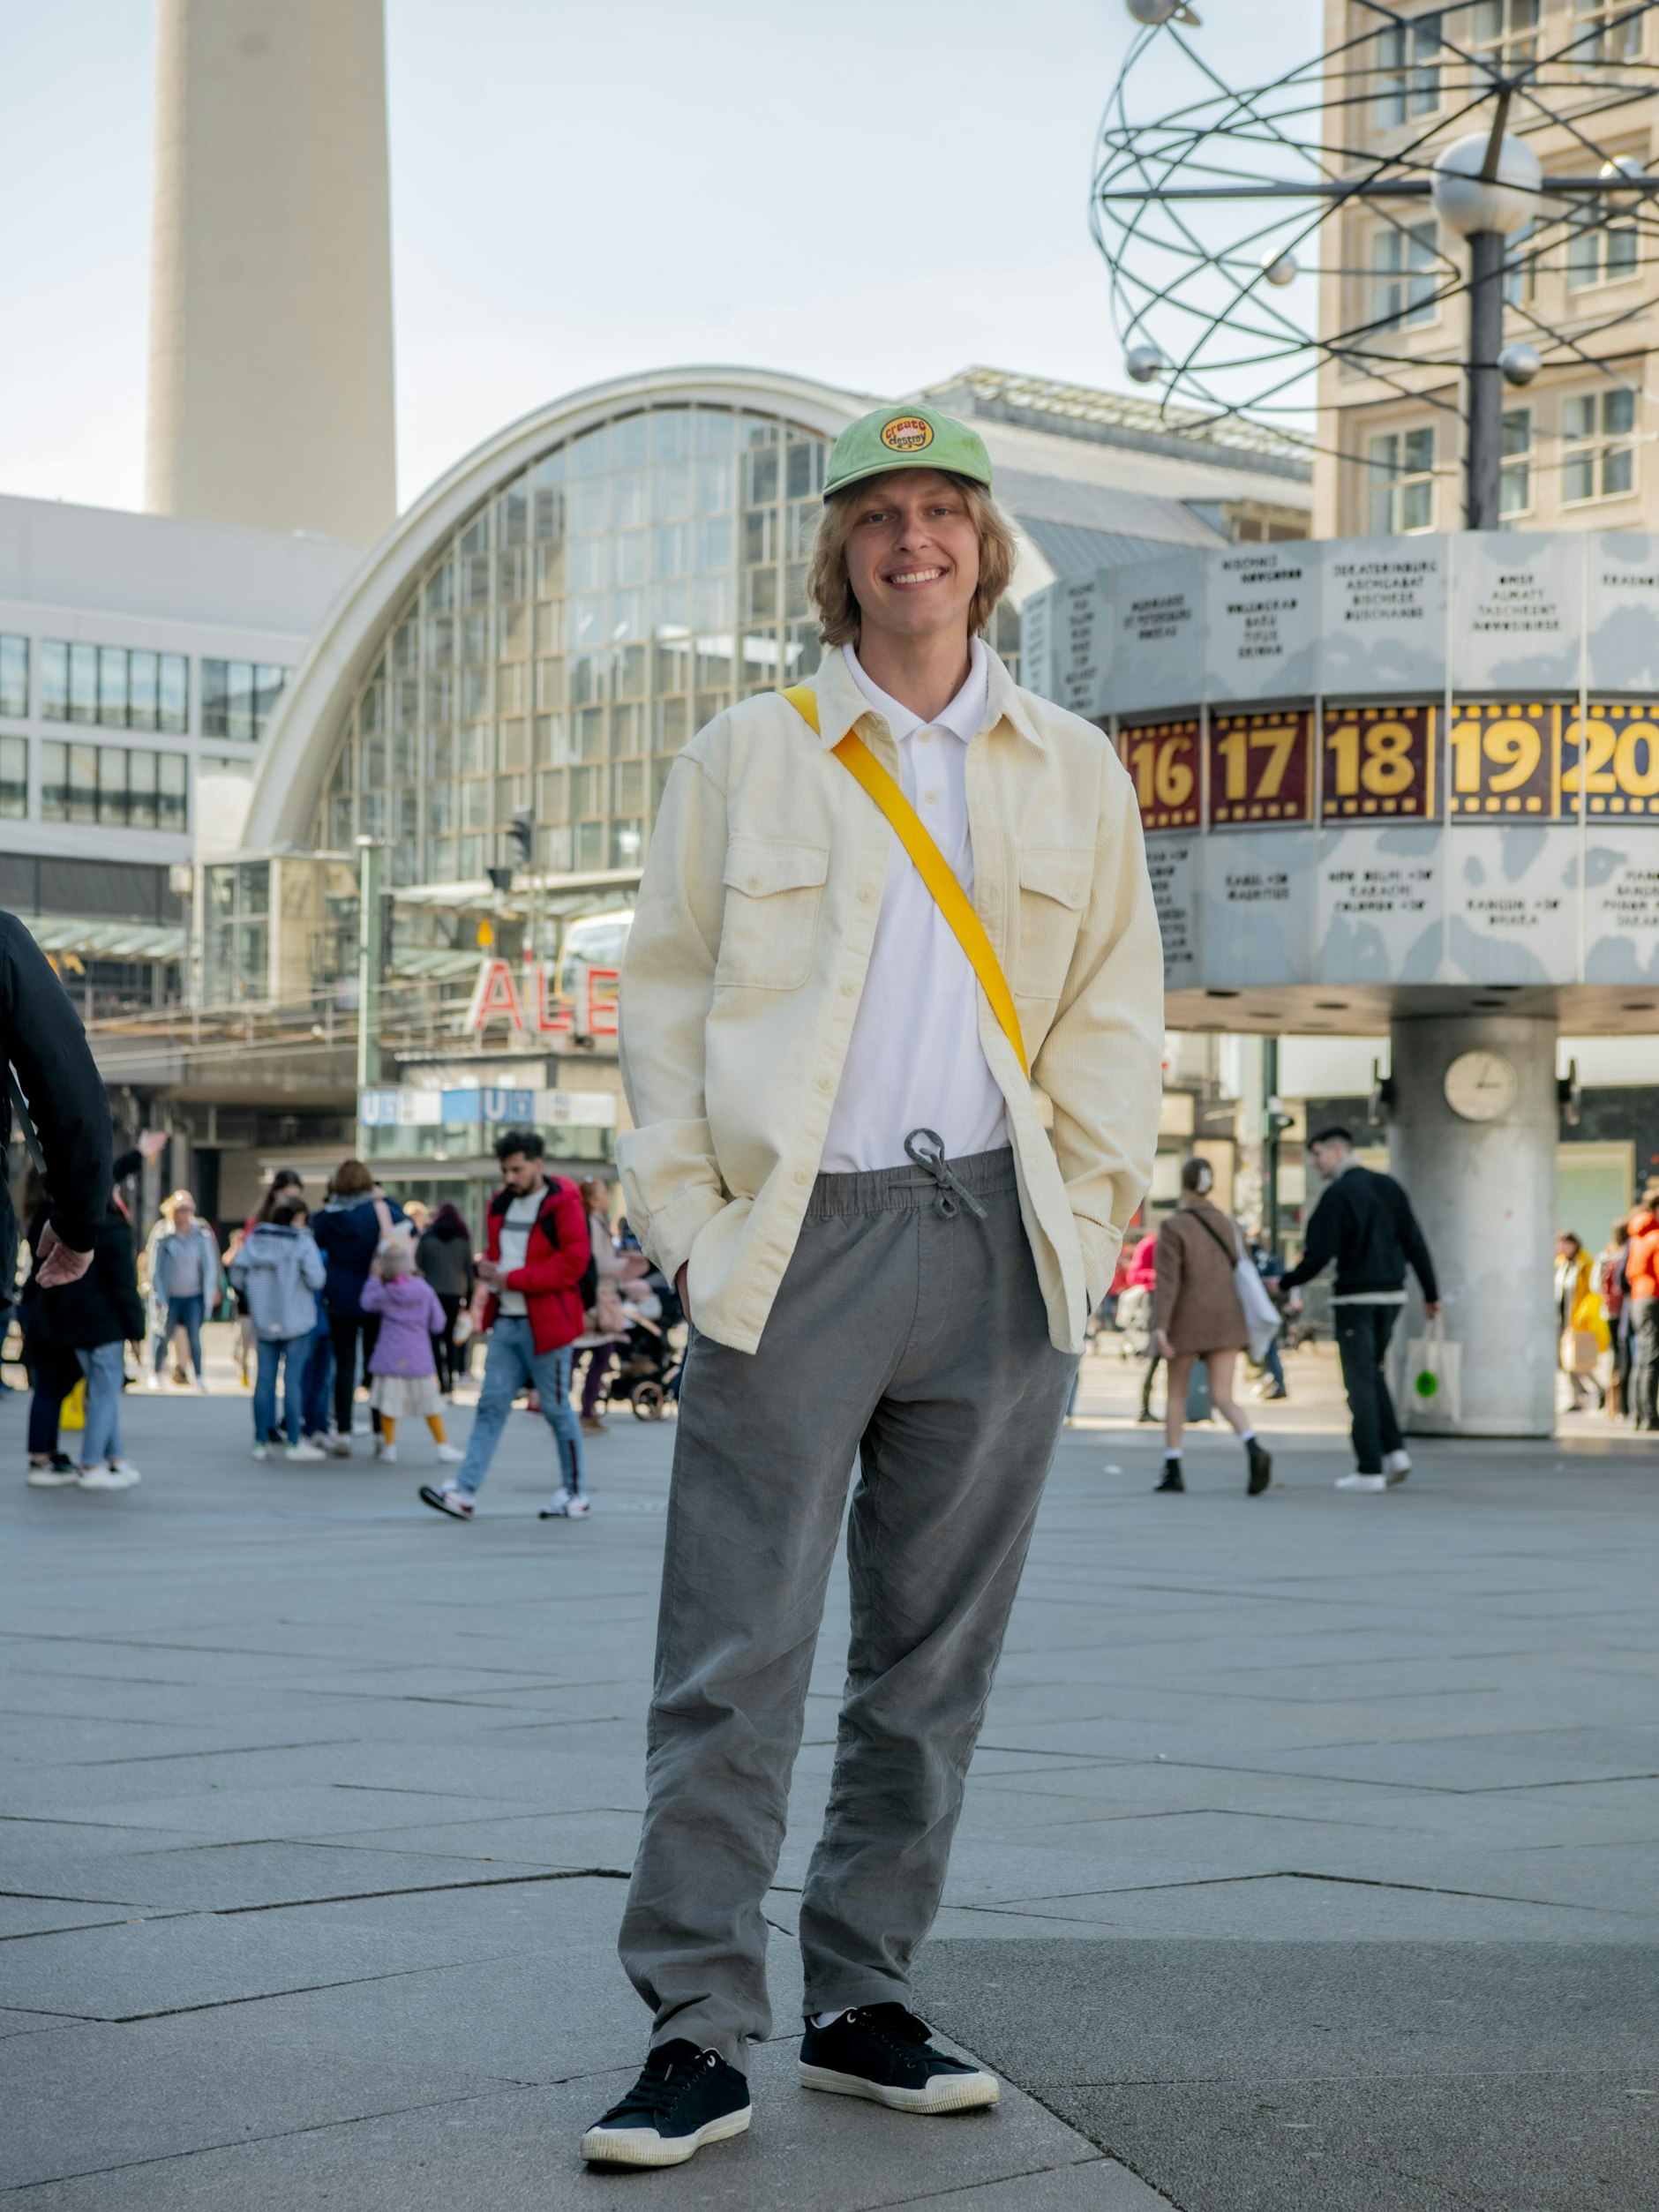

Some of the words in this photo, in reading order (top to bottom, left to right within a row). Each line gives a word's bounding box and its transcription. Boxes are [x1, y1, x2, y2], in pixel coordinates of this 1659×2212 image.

[885, 420, 927, 439] create
[889, 431, 927, 446] destroy
[1130, 736, 1196, 808] 16
[1217, 726, 1299, 801] 17
[1326, 721, 1415, 796] 18
[1449, 719, 1543, 794] 19
[1561, 718, 1659, 797] 20
[484, 1088, 507, 1121] U
